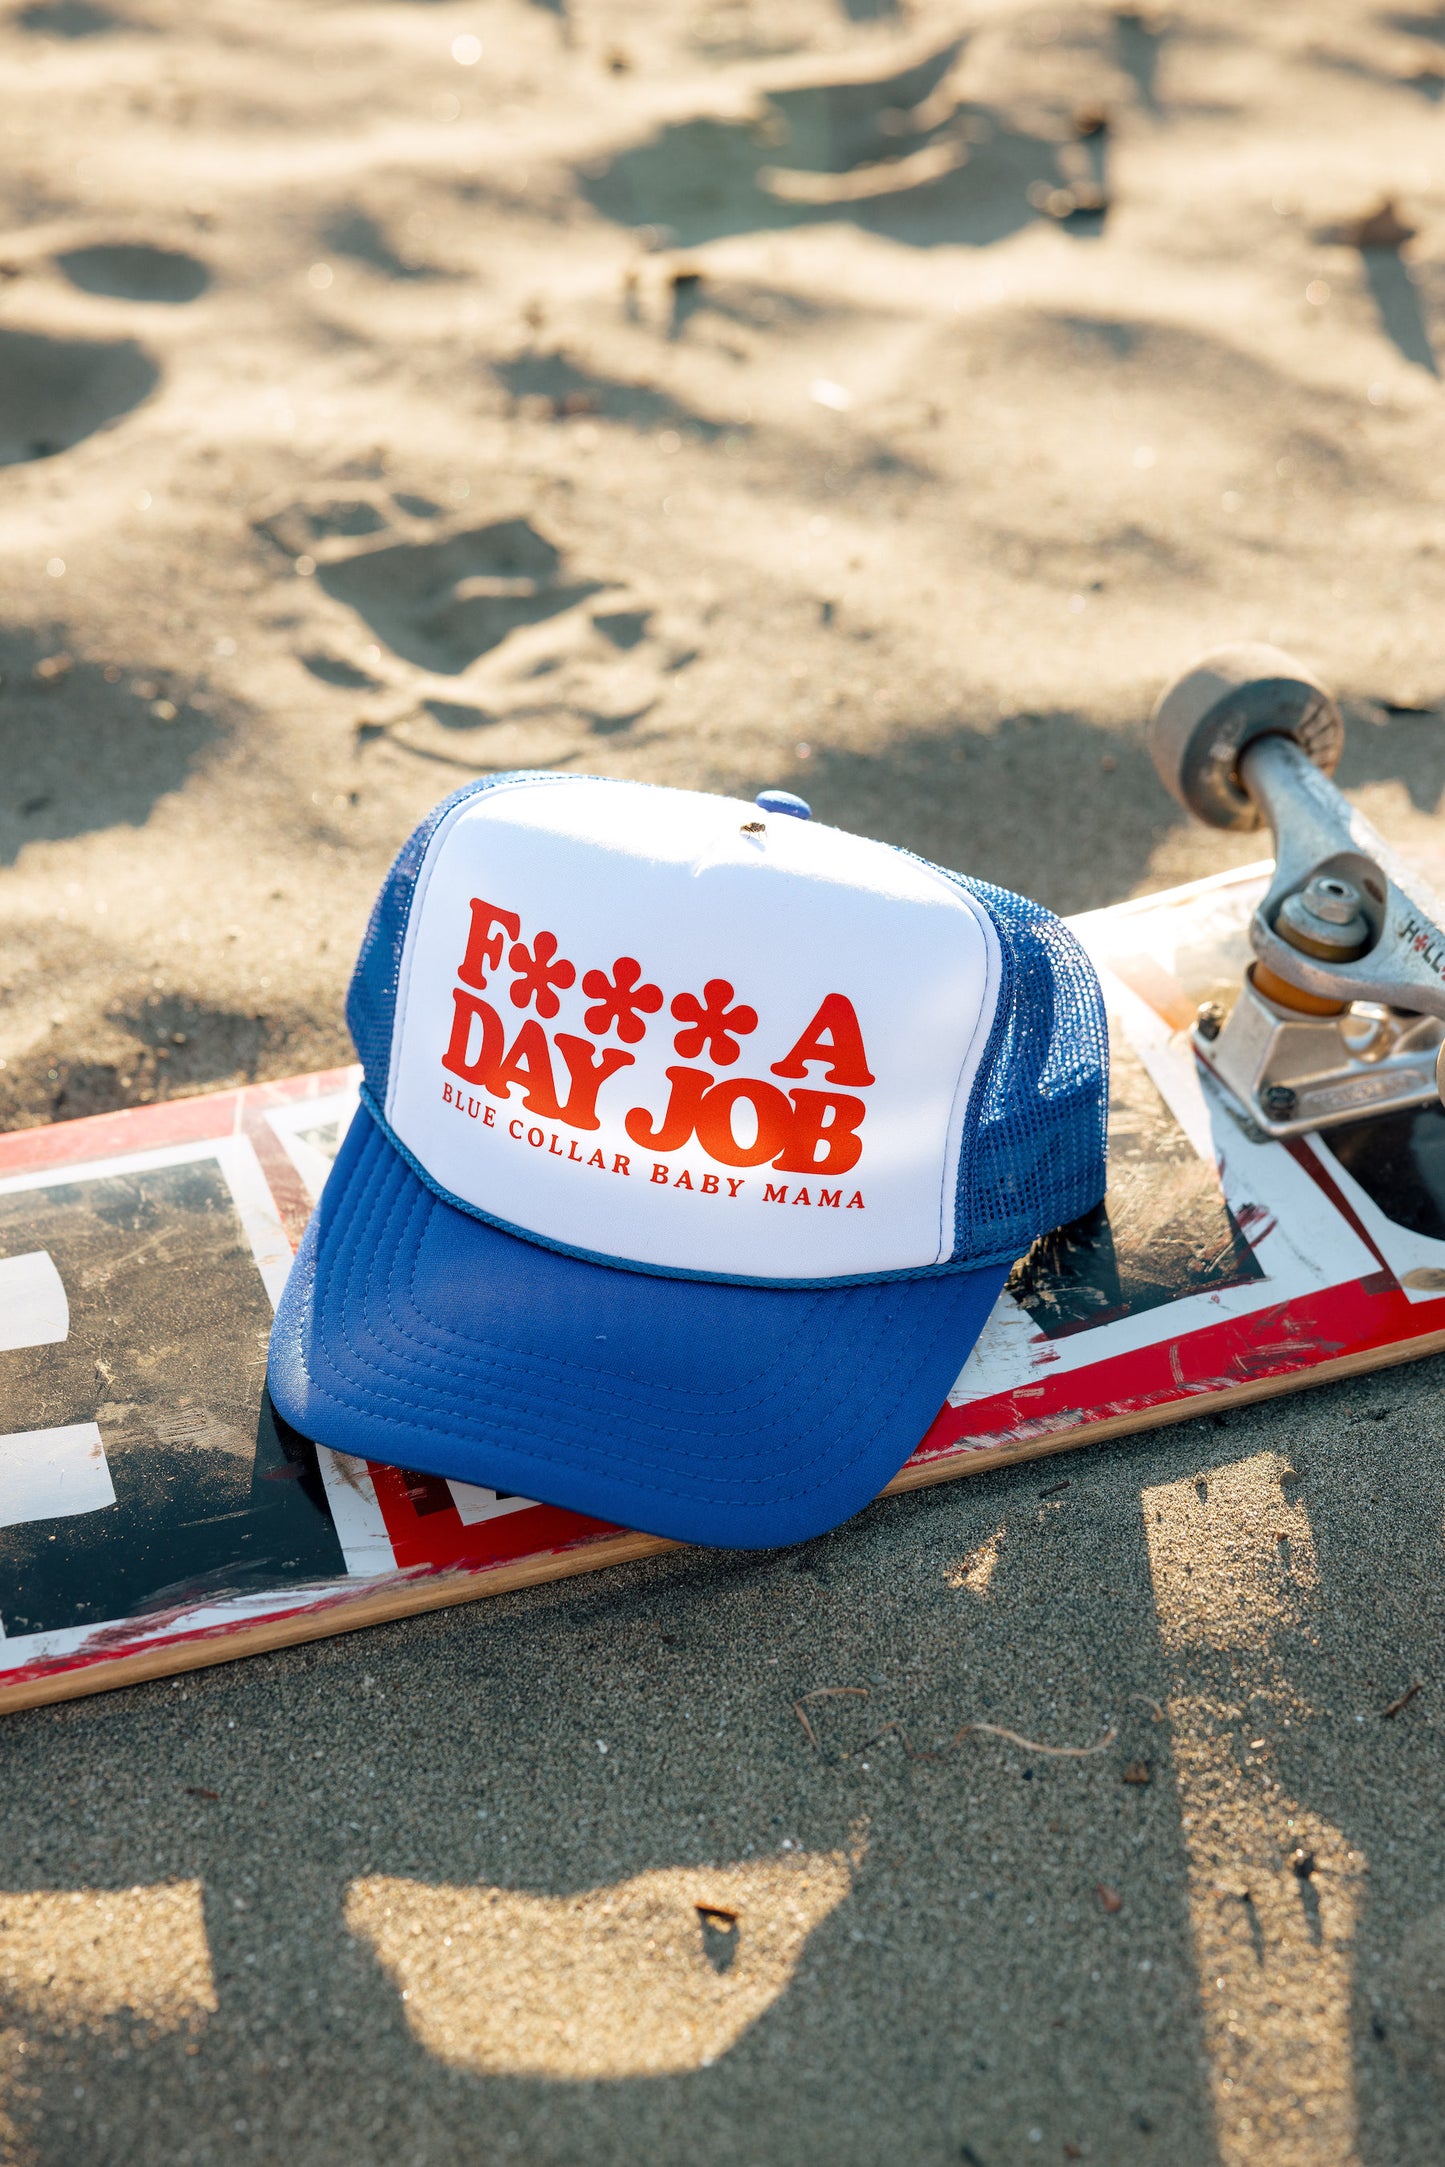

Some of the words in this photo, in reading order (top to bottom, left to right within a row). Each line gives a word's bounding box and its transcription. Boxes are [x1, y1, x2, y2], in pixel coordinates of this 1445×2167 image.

[441, 987, 636, 1132] DAY
[624, 1065, 867, 1176] JOB
[769, 992, 876, 1088] A
[441, 1082, 498, 1128] BLUE
[508, 1119, 632, 1177] COLLAR
[649, 1162, 746, 1199] BABY
[761, 1183, 866, 1210] MAMA
